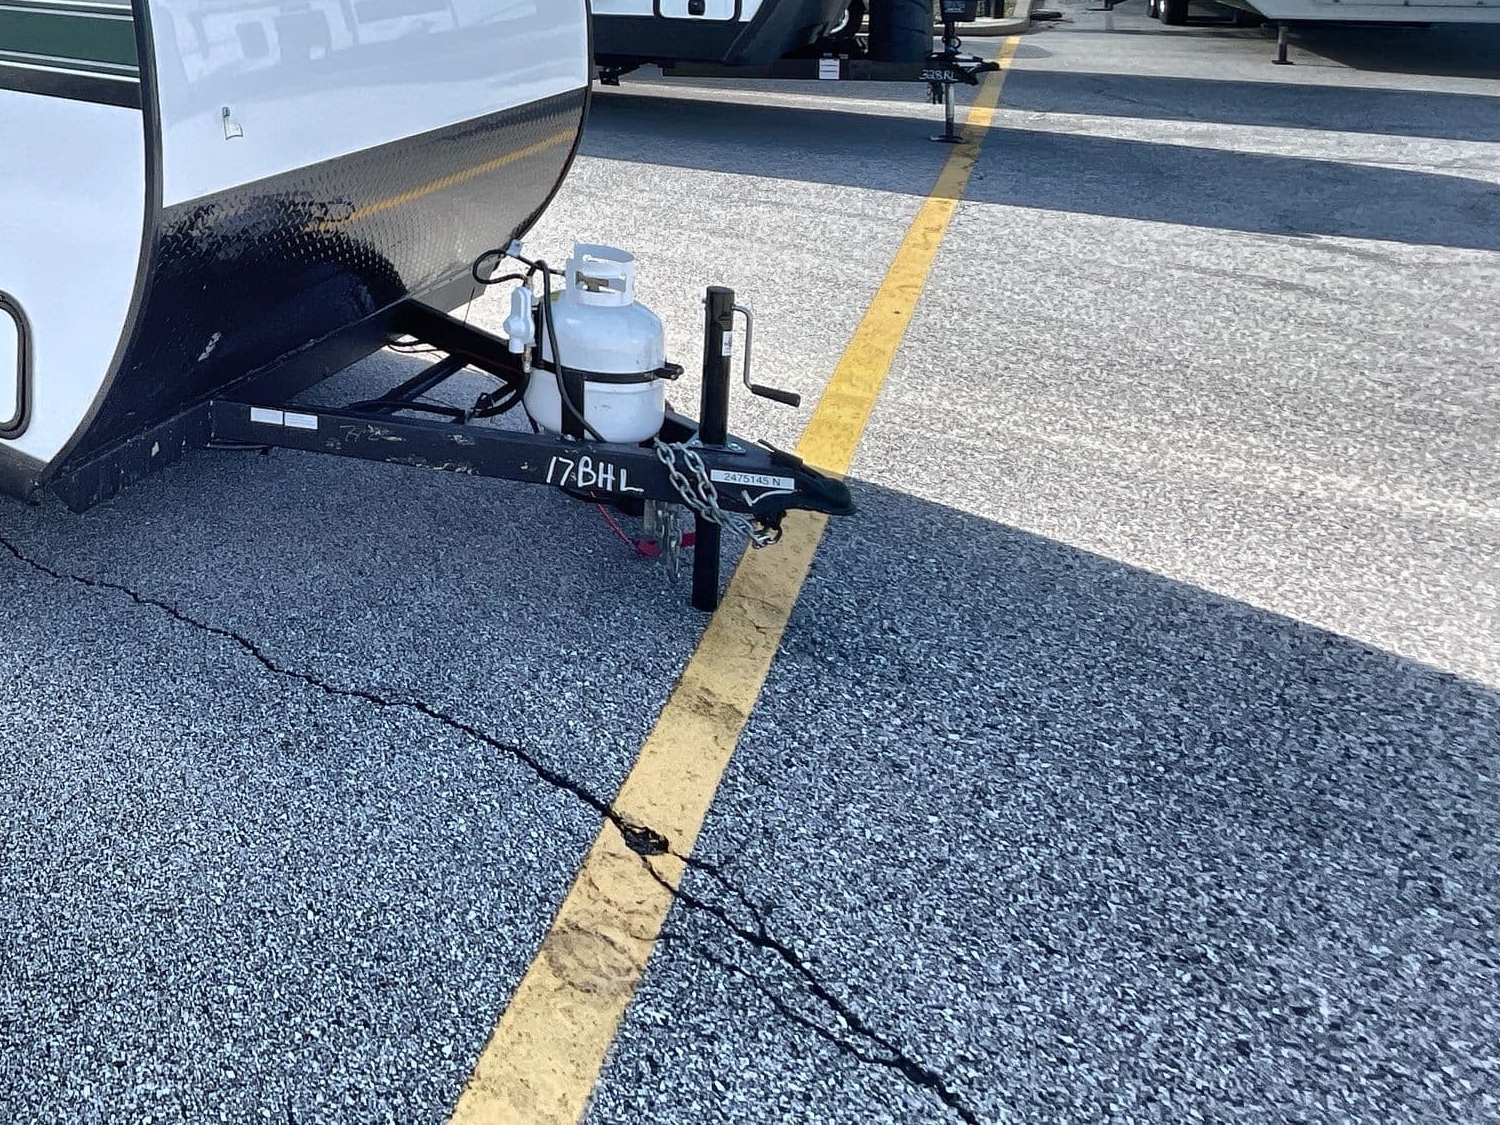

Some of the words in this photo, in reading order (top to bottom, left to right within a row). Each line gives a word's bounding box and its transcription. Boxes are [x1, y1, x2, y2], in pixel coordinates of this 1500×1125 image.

[546, 455, 645, 492] 17BHL
[723, 472, 769, 486] 2475145
[771, 477, 781, 487] N
